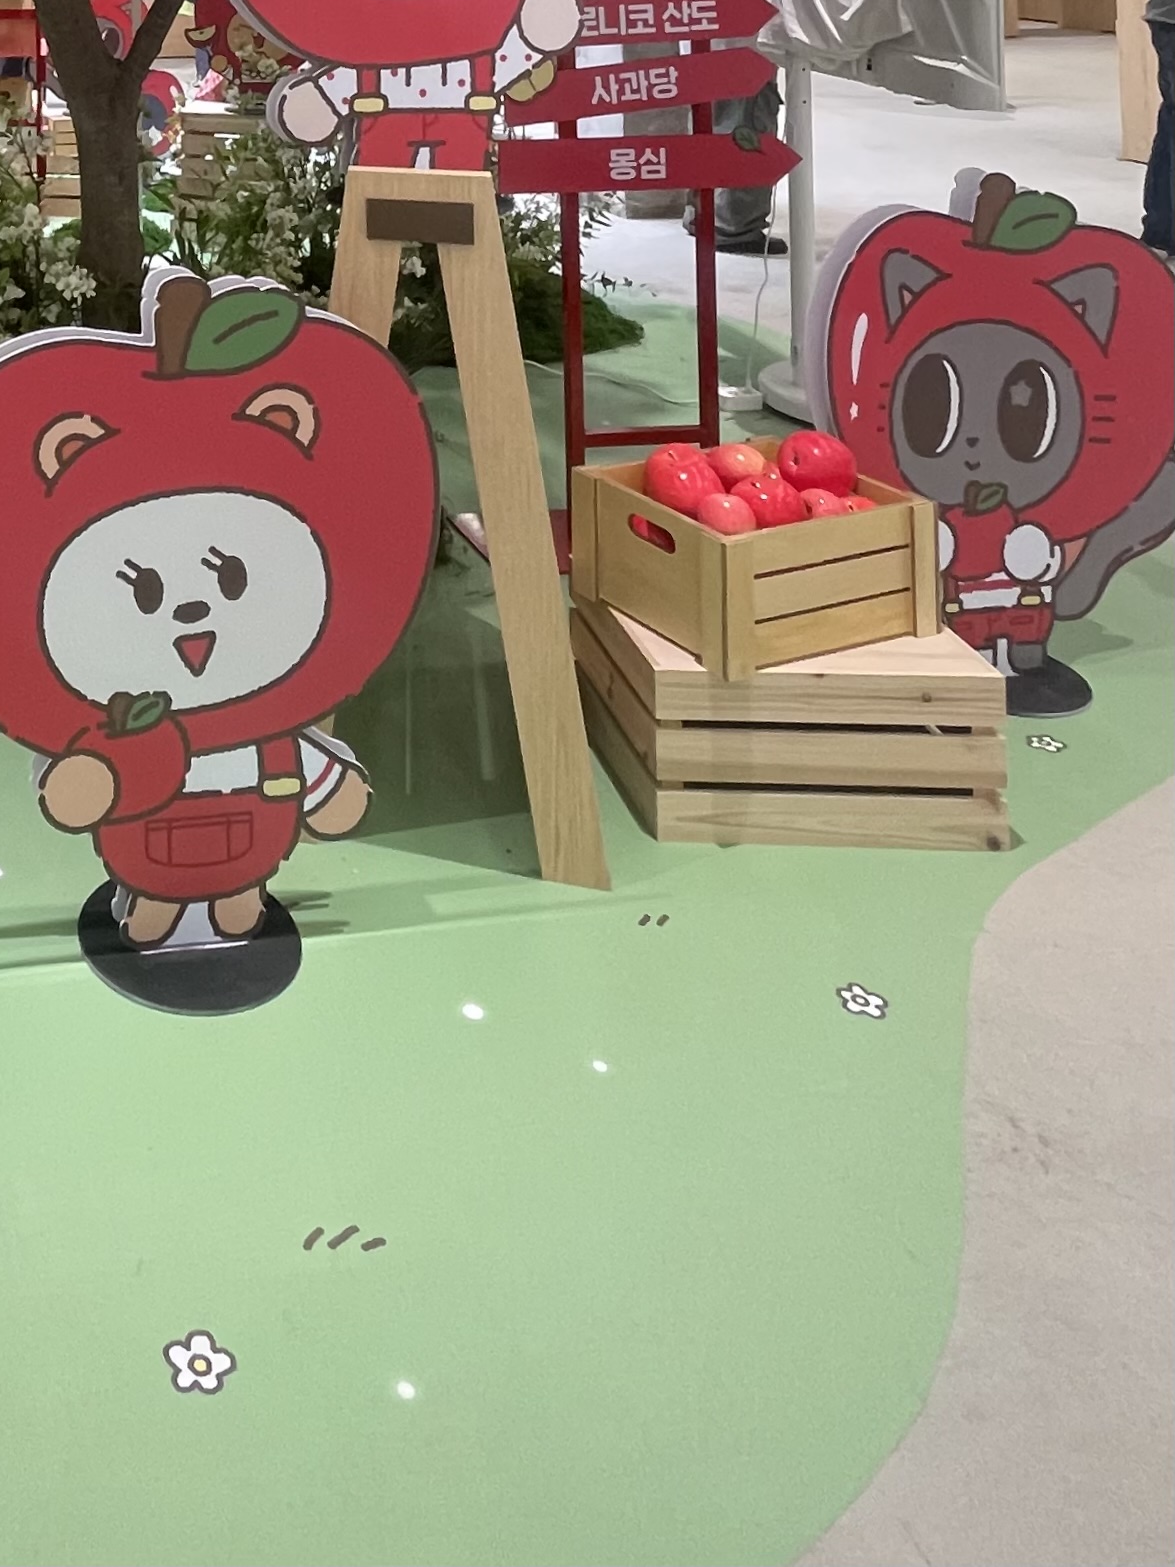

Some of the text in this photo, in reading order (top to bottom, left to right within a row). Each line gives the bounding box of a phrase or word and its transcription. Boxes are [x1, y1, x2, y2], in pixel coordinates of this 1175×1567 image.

[662, 0, 719, 33] 산도
[591, 66, 679, 105] 사과당
[608, 147, 667, 180] 몽심
